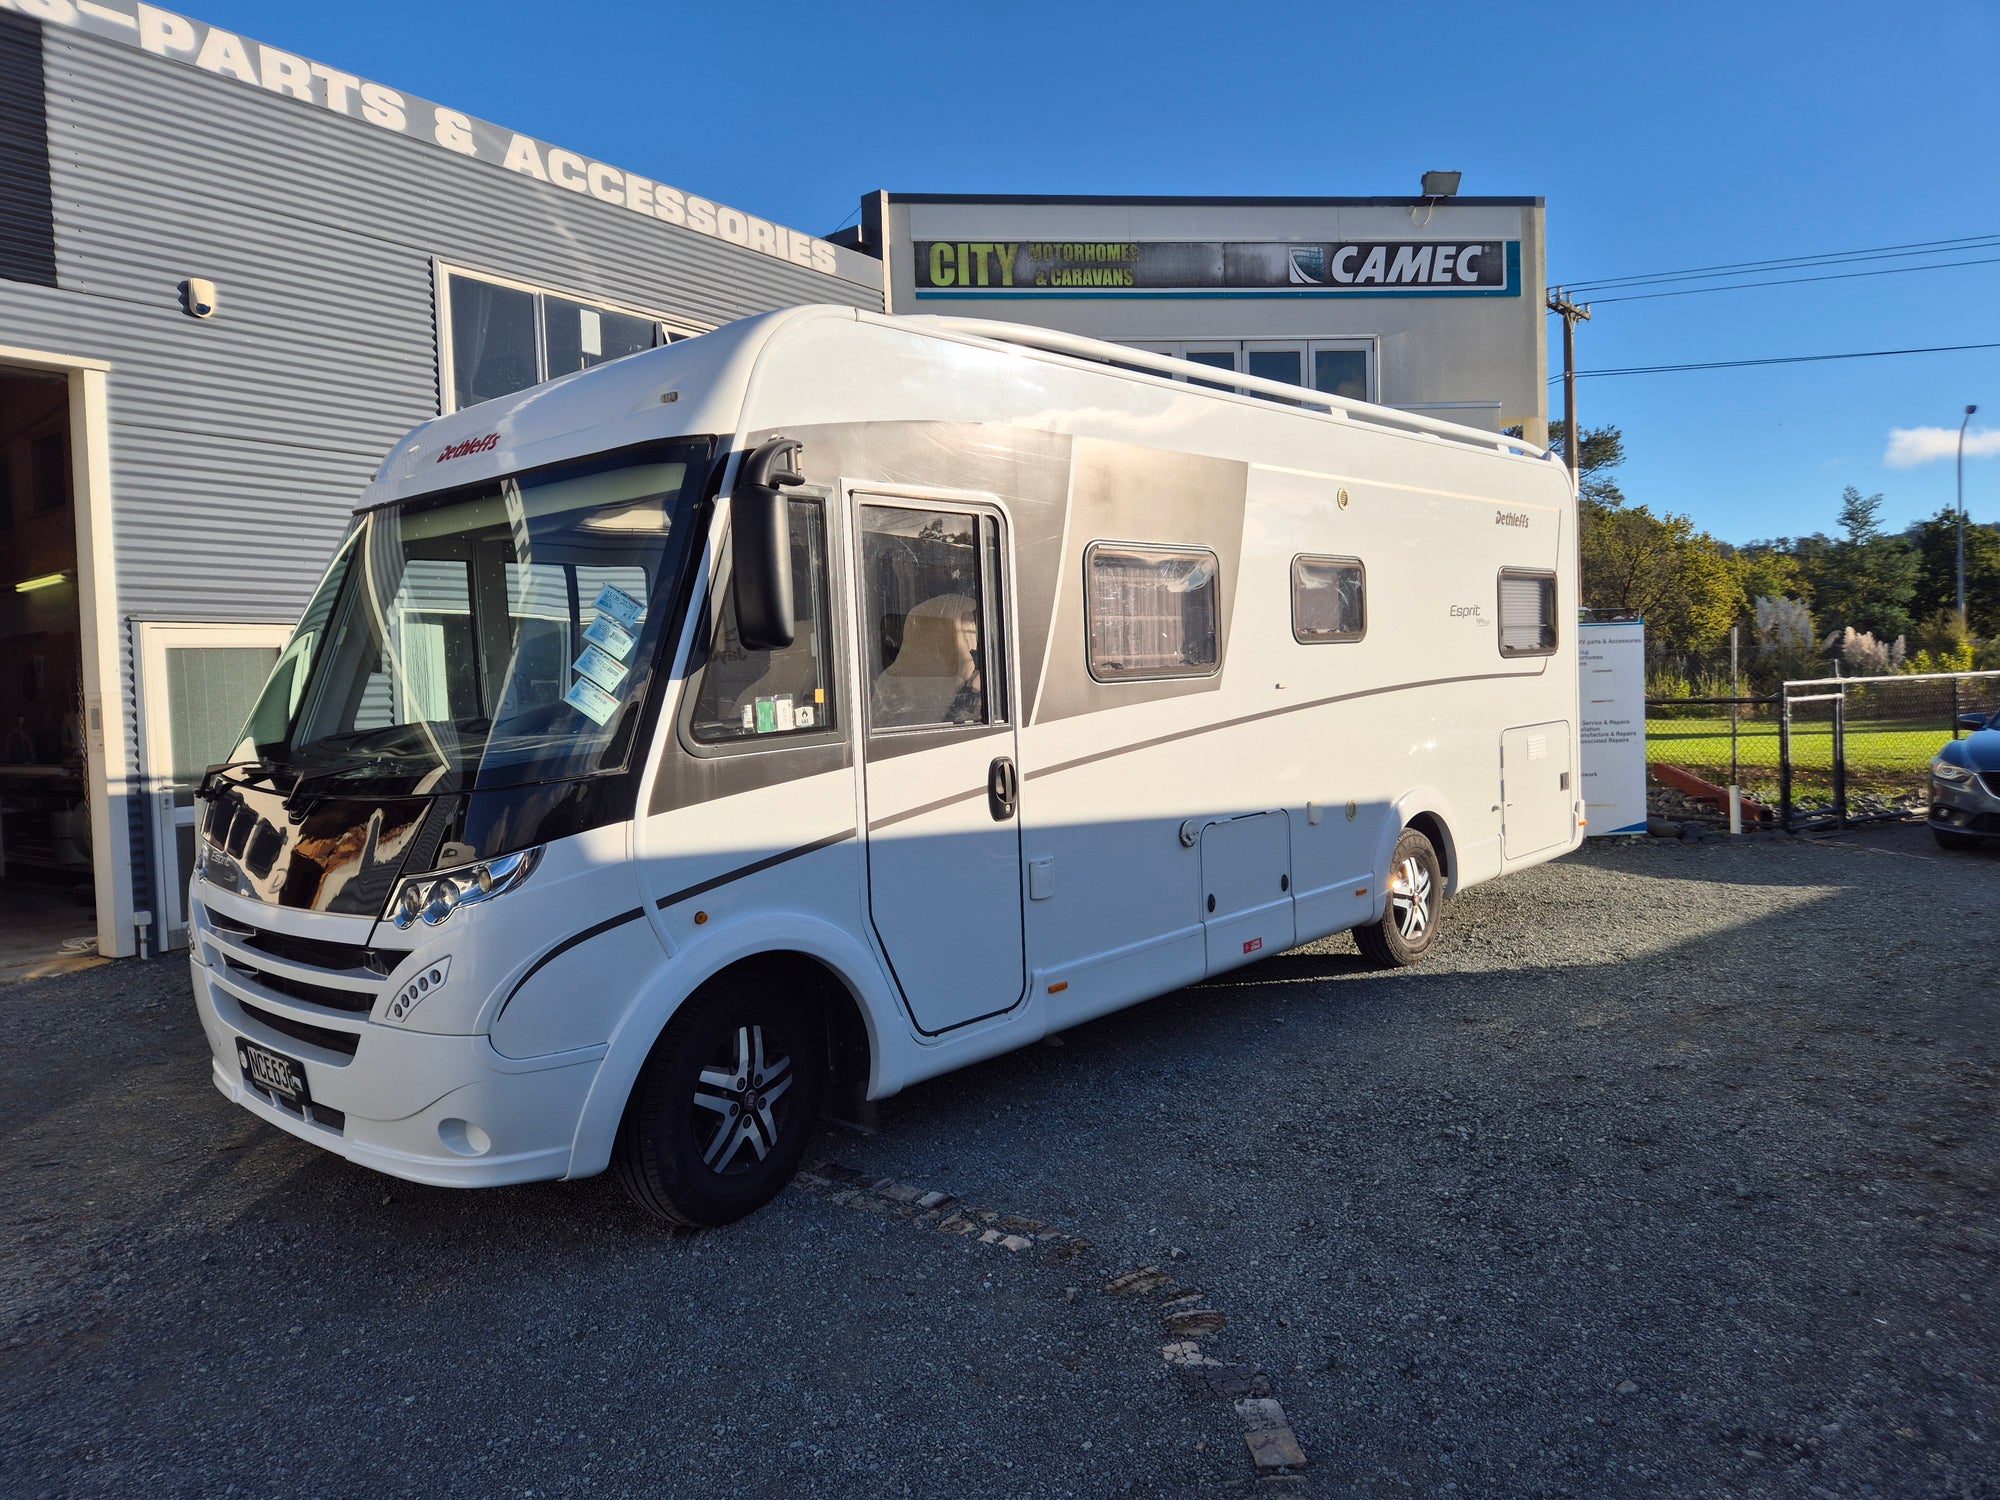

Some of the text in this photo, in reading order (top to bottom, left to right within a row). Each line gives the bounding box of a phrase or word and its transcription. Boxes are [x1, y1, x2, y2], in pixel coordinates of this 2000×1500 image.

[433, 106, 477, 157] &
[503, 133, 837, 275] ACCESSORIES
[929, 242, 1140, 287] CITY MOTORHOMES
[1035, 268, 1134, 287] & CARAVANS
[1331, 245, 1483, 283] CAMEC
[436, 432, 501, 463] Dethleffs
[1495, 510, 1530, 528] Dethleffs
[1449, 604, 1481, 619] Esprit
